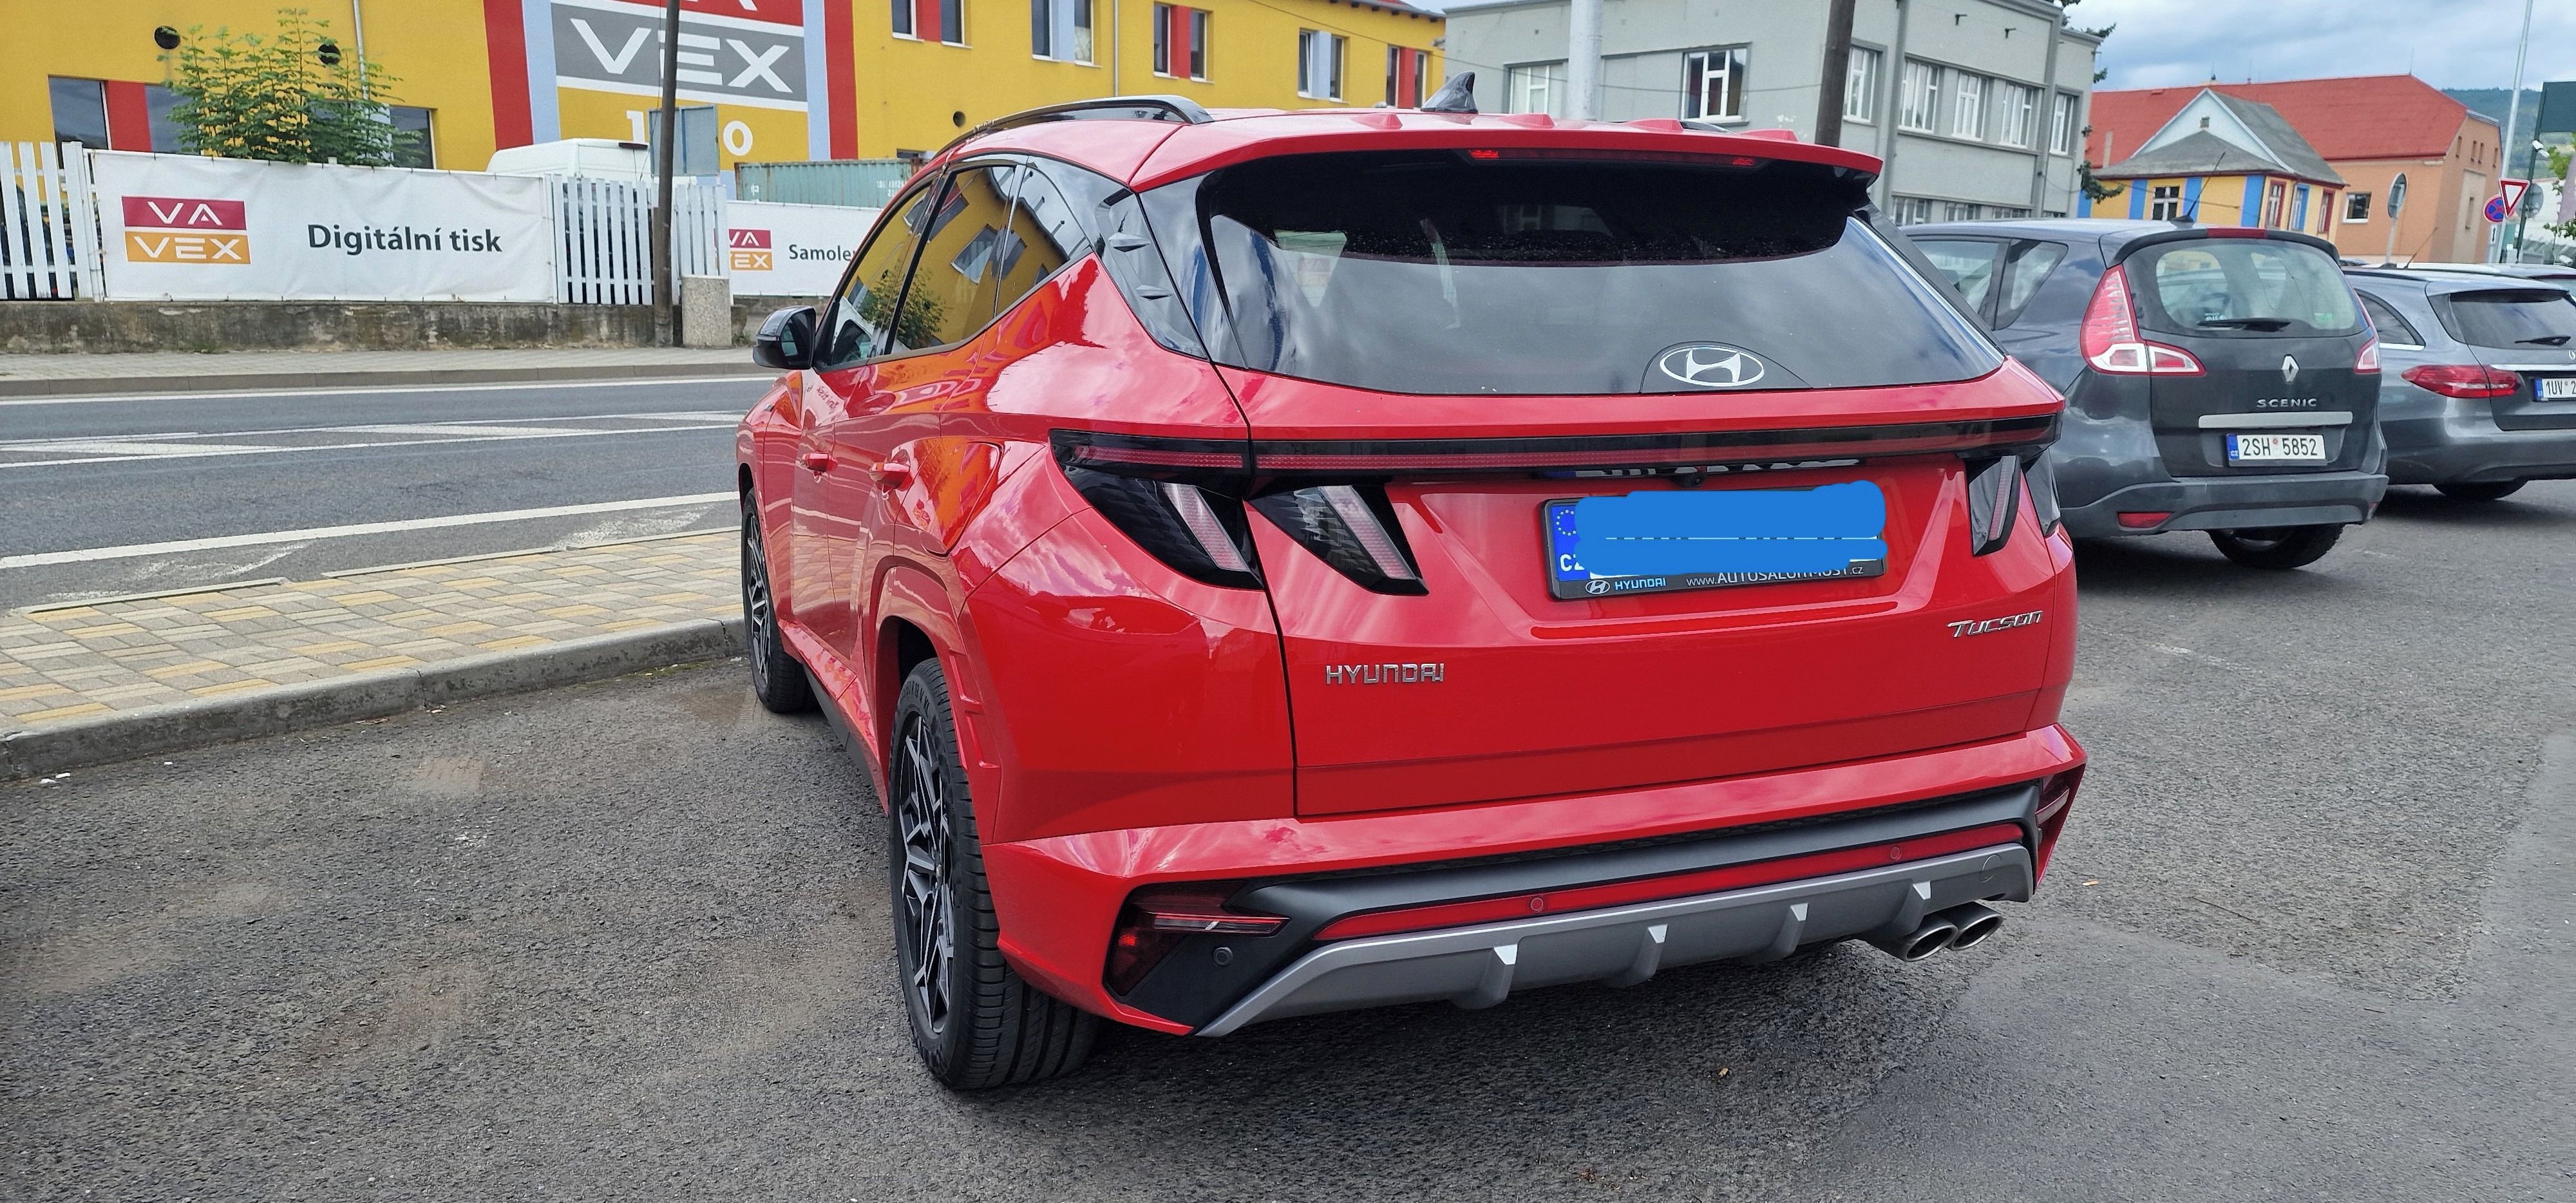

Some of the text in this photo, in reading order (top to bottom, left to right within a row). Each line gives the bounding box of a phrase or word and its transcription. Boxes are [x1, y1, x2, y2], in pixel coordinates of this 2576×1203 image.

[570, 18, 793, 93] VEX
[147, 201, 223, 226] VA
[133, 236, 242, 260] VEX
[308, 224, 503, 256] Digitální tisk
[730, 253, 770, 269] EX
[789, 244, 855, 261] Samole
[2546, 381, 2562, 395] 1UV
[2256, 398, 2317, 408] SCENIC
[2242, 437, 2318, 456] 2SH 5852
[1615, 577, 1667, 591] HYUNDAI
[1325, 663, 1444, 685] HYUNDAI
